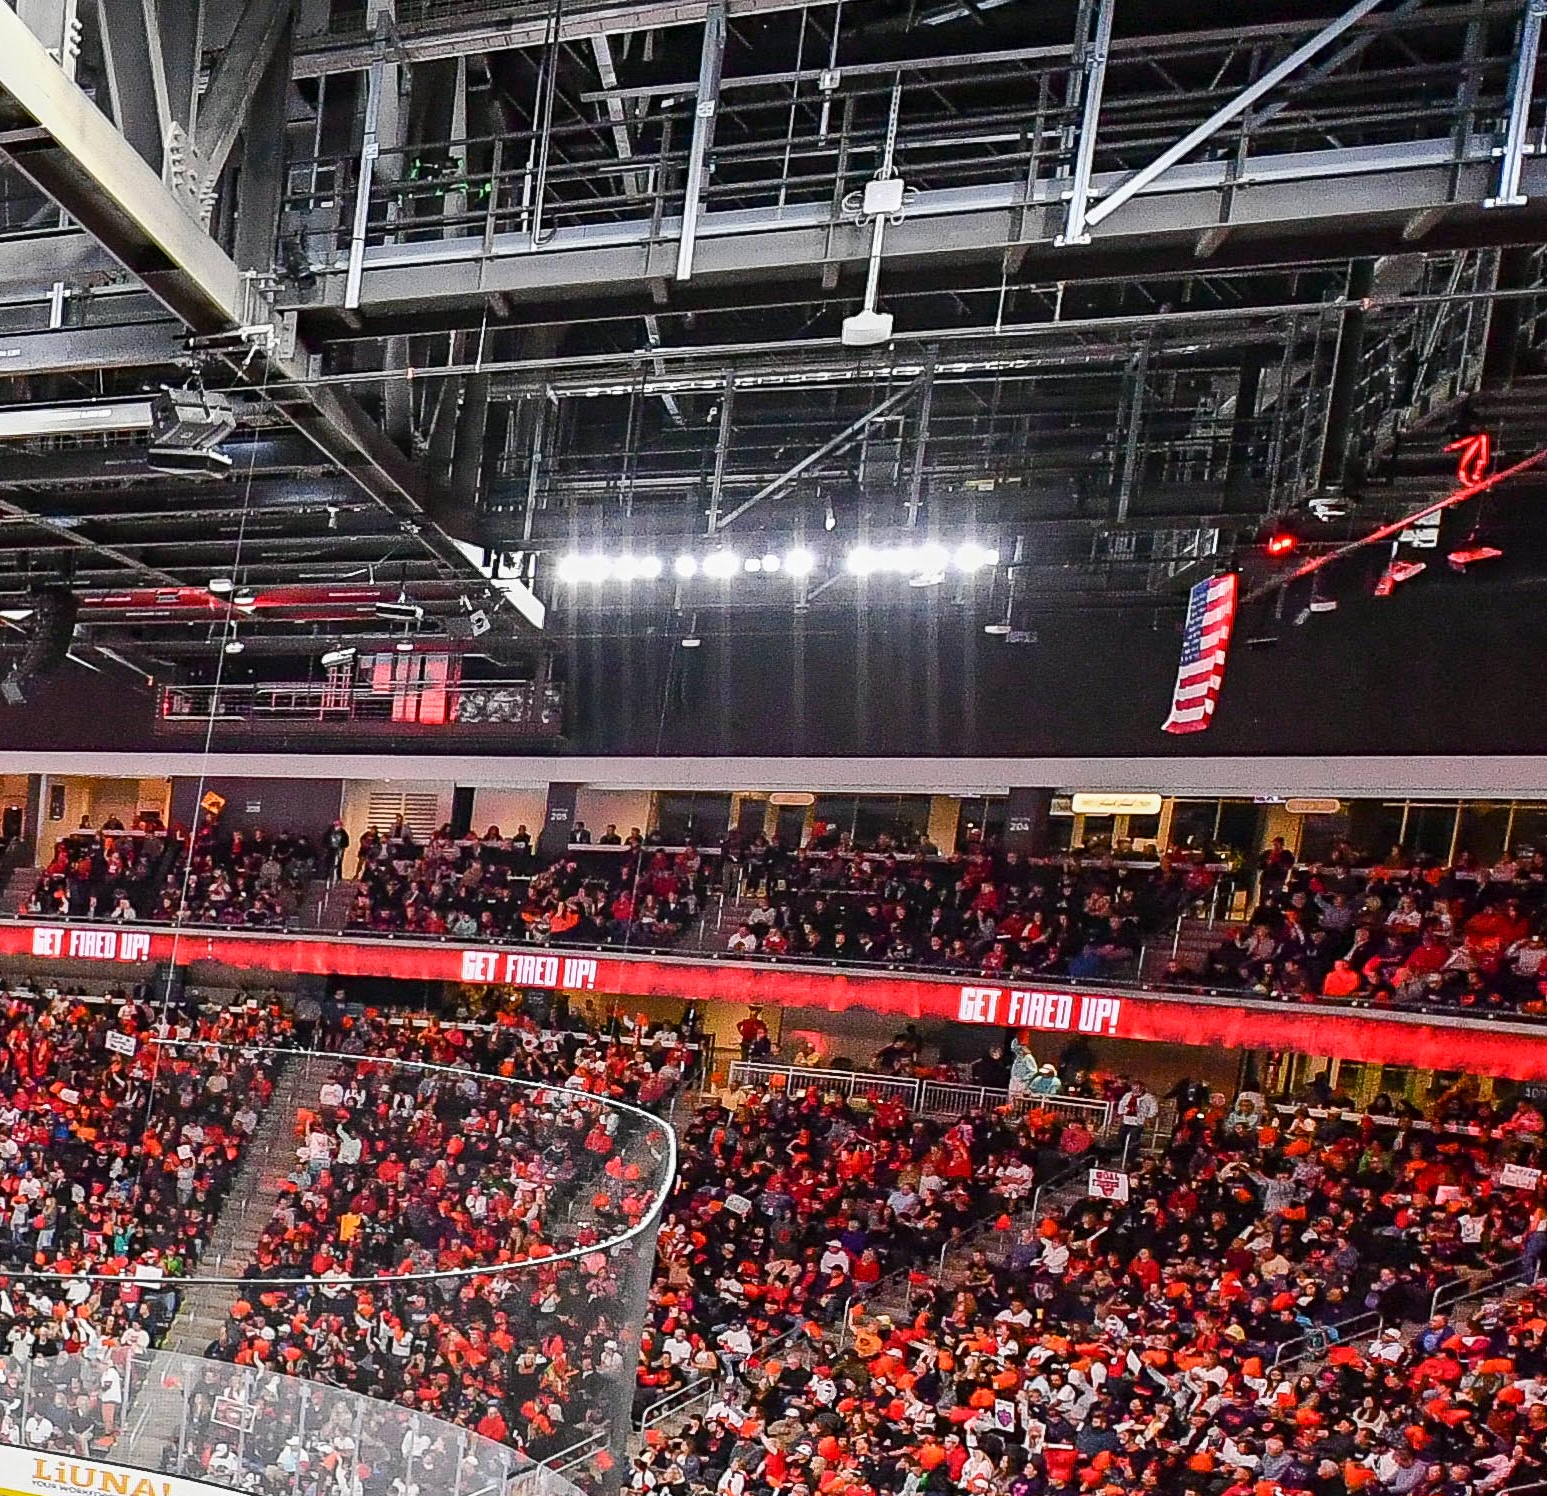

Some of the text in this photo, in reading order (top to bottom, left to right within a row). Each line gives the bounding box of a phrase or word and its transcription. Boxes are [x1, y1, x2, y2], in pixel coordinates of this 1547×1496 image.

[32, 927, 150, 961] GET FIRED UP!
[462, 951, 597, 990] GET FIRED UP!
[959, 987, 1121, 1034] GET FIRED UP!
[32, 1480, 58, 1491] YOUR
